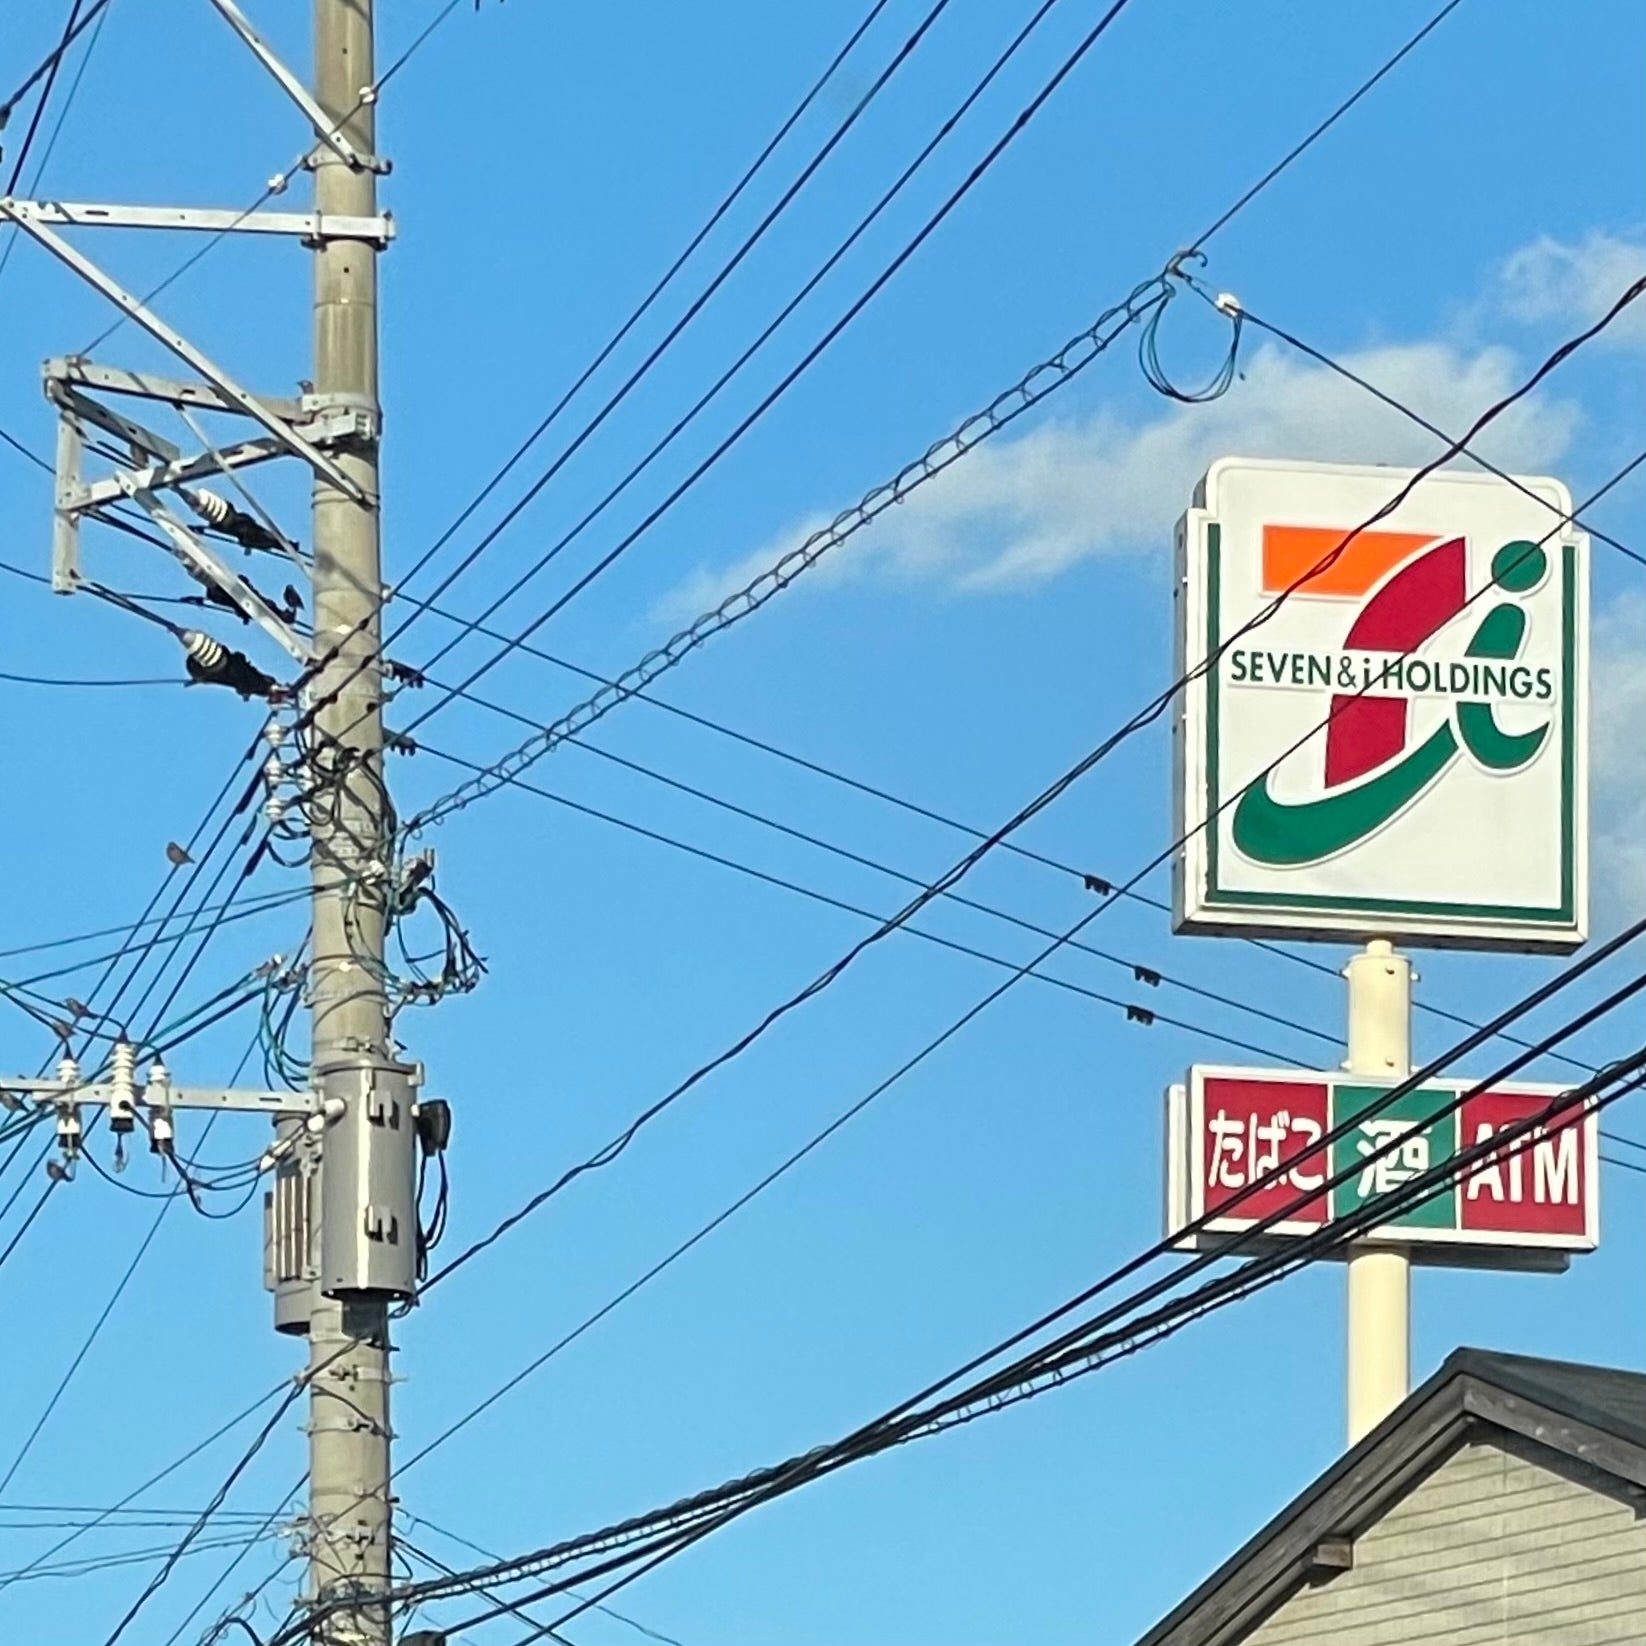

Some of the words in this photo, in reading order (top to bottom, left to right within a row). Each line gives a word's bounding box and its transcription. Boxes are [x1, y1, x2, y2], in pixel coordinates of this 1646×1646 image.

[1382, 658, 1552, 700] HOLDINGS
[1208, 1109, 1324, 1191] たばこ
[1356, 1119, 1434, 1200] 酒
[1466, 1122, 1579, 1206] ATM
